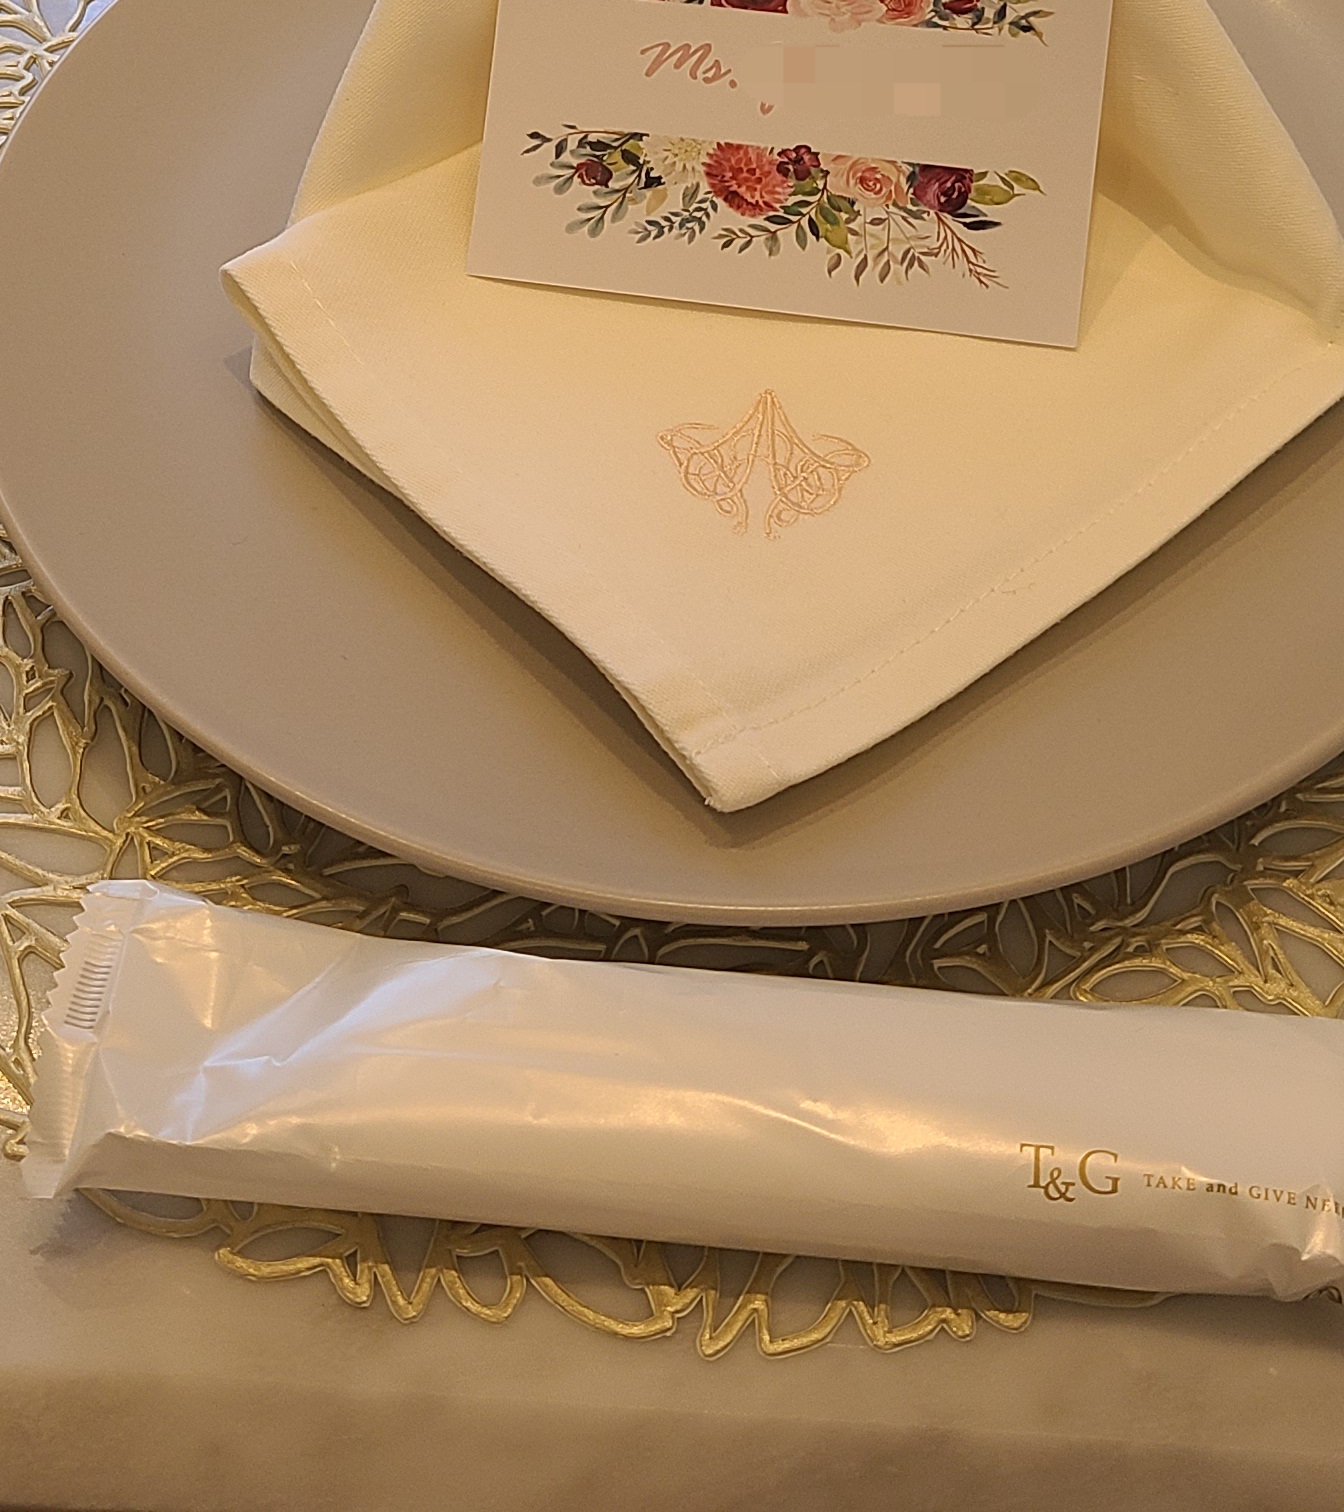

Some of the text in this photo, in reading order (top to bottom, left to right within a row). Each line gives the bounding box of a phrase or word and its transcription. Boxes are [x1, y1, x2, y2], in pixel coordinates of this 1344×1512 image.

[639, 41, 738, 89] Ms.
[1019, 1143, 1120, 1203] T&G
[1142, 1173, 1197, 1191] TAKE
[1205, 1182, 1239, 1196] and
[1248, 1185, 1298, 1207] GIVE
